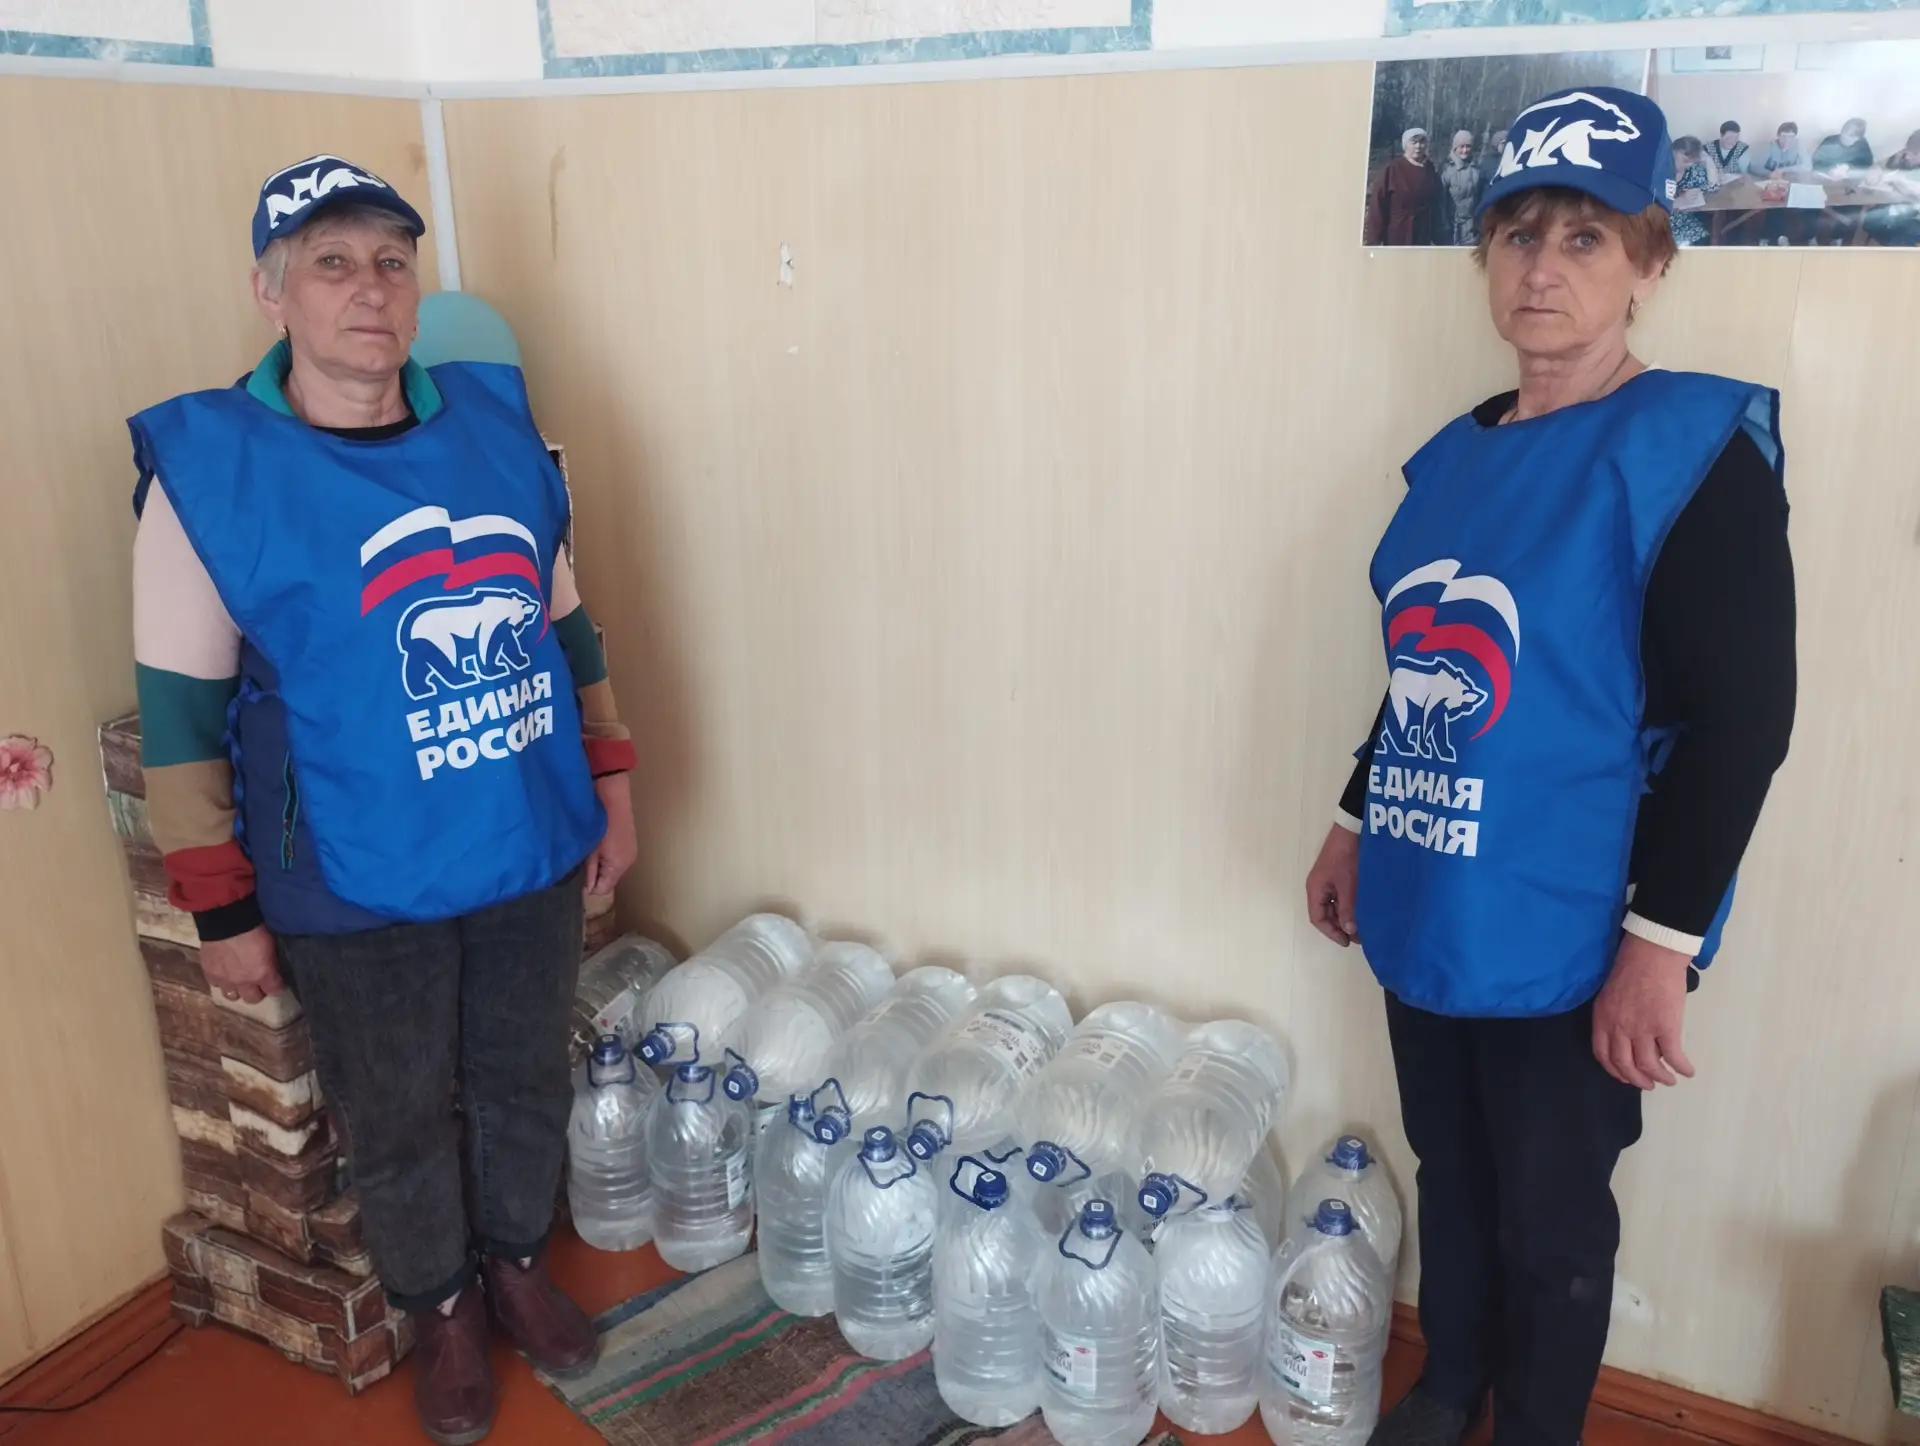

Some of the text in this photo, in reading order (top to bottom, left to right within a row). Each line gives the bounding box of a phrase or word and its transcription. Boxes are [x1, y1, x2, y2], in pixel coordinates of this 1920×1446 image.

[406, 672, 552, 742] ЕДИНАЯ
[416, 706, 553, 780] РОССИЯ
[1369, 764, 1484, 811] ЕДИНАЯ
